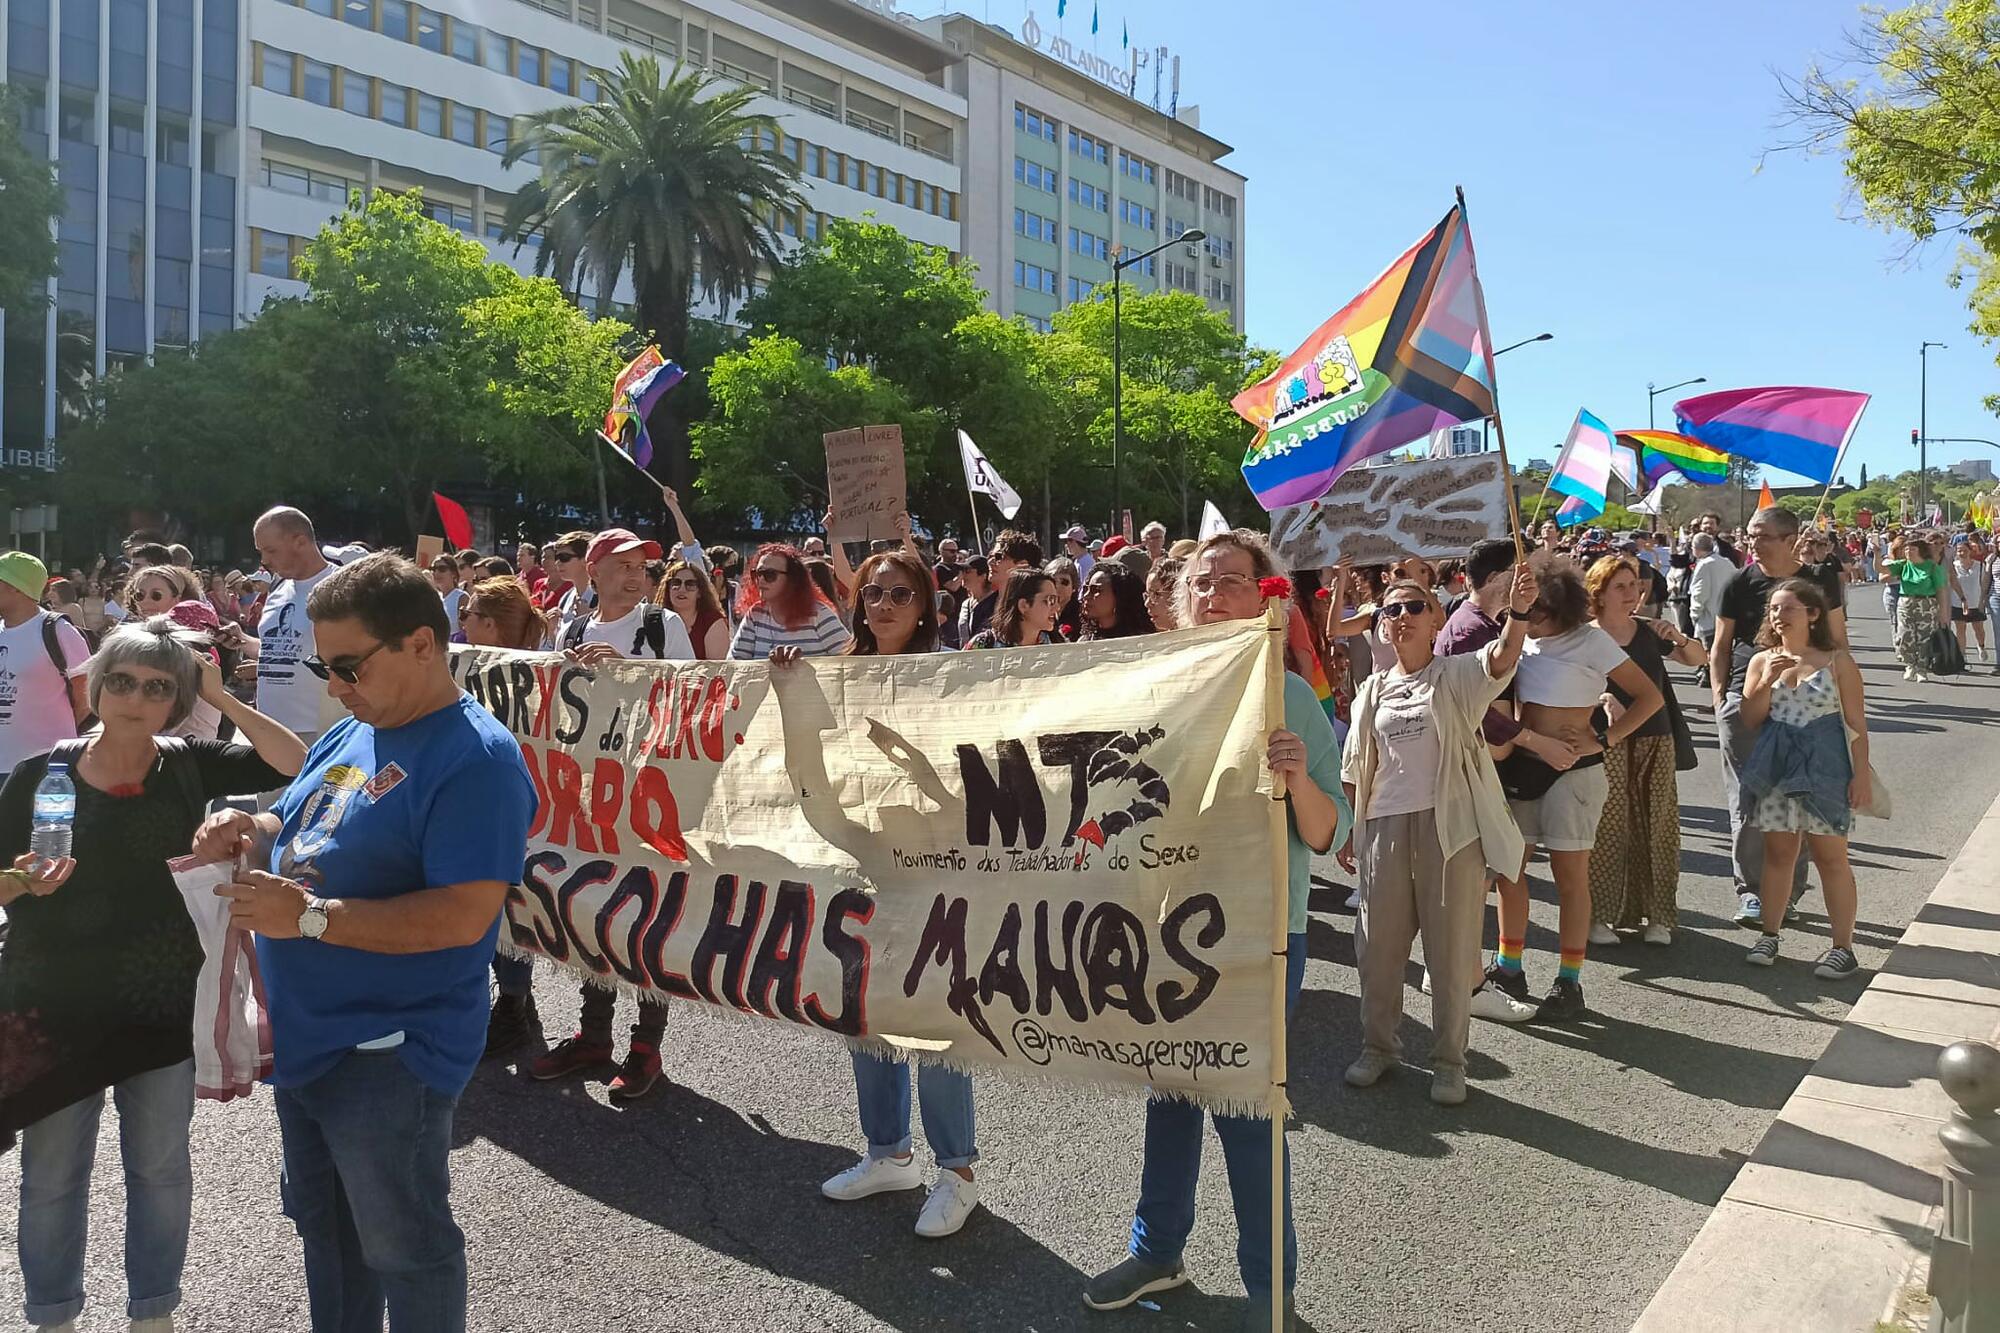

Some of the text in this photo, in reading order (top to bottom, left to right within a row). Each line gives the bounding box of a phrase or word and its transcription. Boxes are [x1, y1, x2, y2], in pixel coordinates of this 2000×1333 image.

[599, 706, 624, 751] do
[893, 848, 967, 872] Movimento
[977, 850, 1001, 872] dxs
[1109, 851, 1129, 871] do
[1139, 834, 1200, 870] Sexo
[503, 850, 875, 1037] ESCOLHAS
[1012, 1018, 1250, 1081] @manasaferspace
